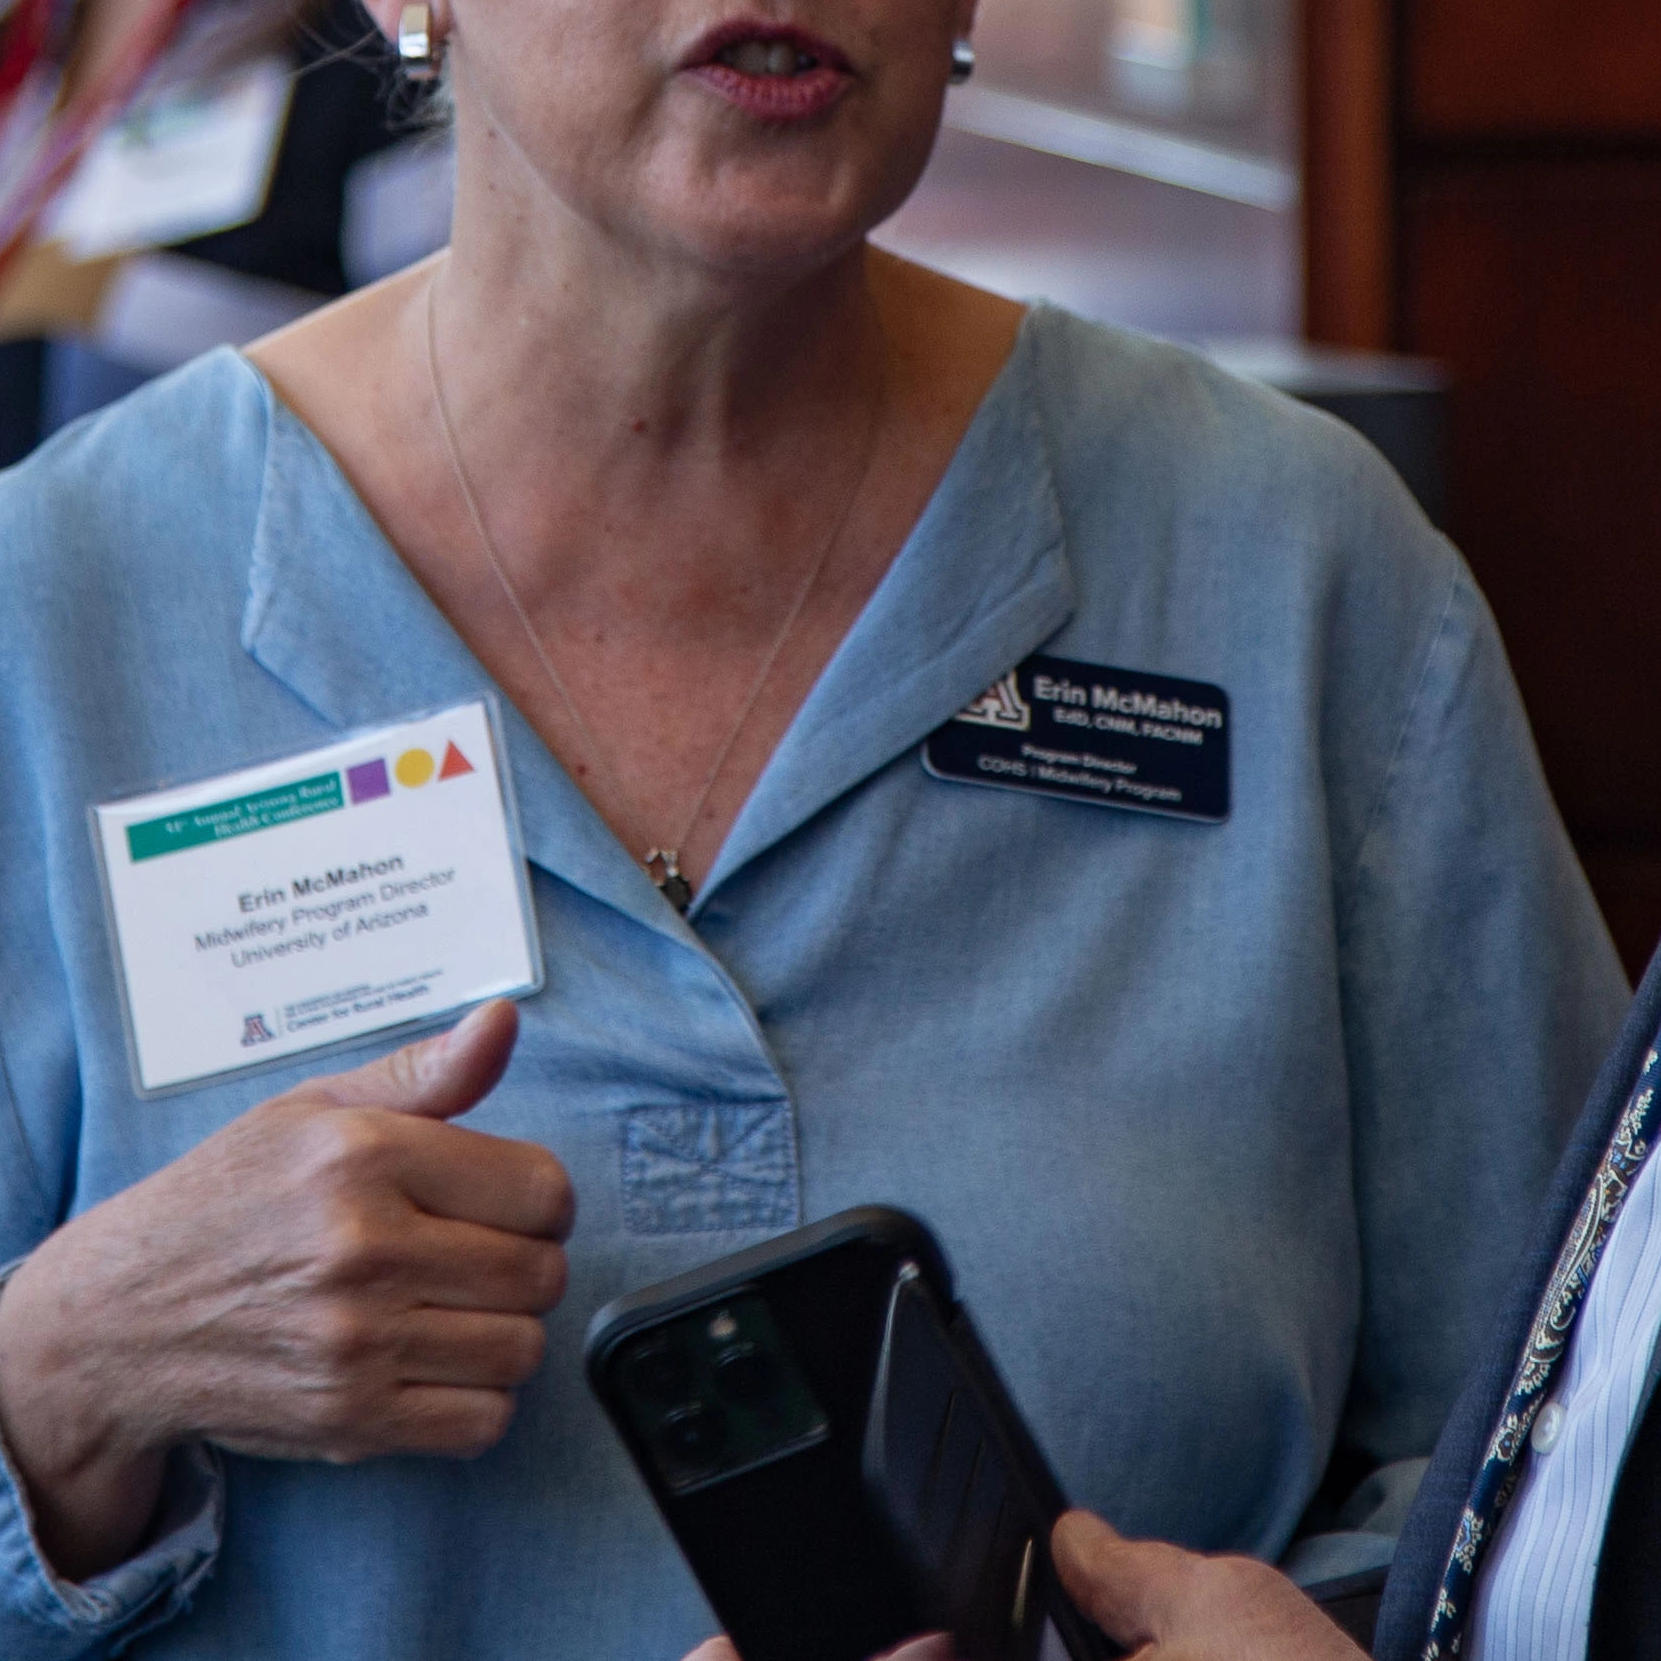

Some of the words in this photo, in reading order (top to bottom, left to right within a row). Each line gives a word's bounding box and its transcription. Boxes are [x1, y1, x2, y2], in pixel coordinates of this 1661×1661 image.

[1033, 674, 1086, 706] Erin
[1092, 684, 1223, 729] McMahon
[1039, 765, 1112, 794] Midwifery
[1114, 777, 1183, 803] Program
[1083, 753, 1138, 775] Director
[262, 796, 338, 825] Conference
[298, 779, 337, 799] Rural
[238, 888, 286, 913] Erin
[291, 855, 405, 899] McMahon
[194, 916, 286, 952] Midwifery
[291, 891, 376, 925] Program
[379, 868, 455, 902] Director
[230, 931, 327, 968] University
[332, 920, 351, 941] of
[355, 902, 429, 935] Arizona
